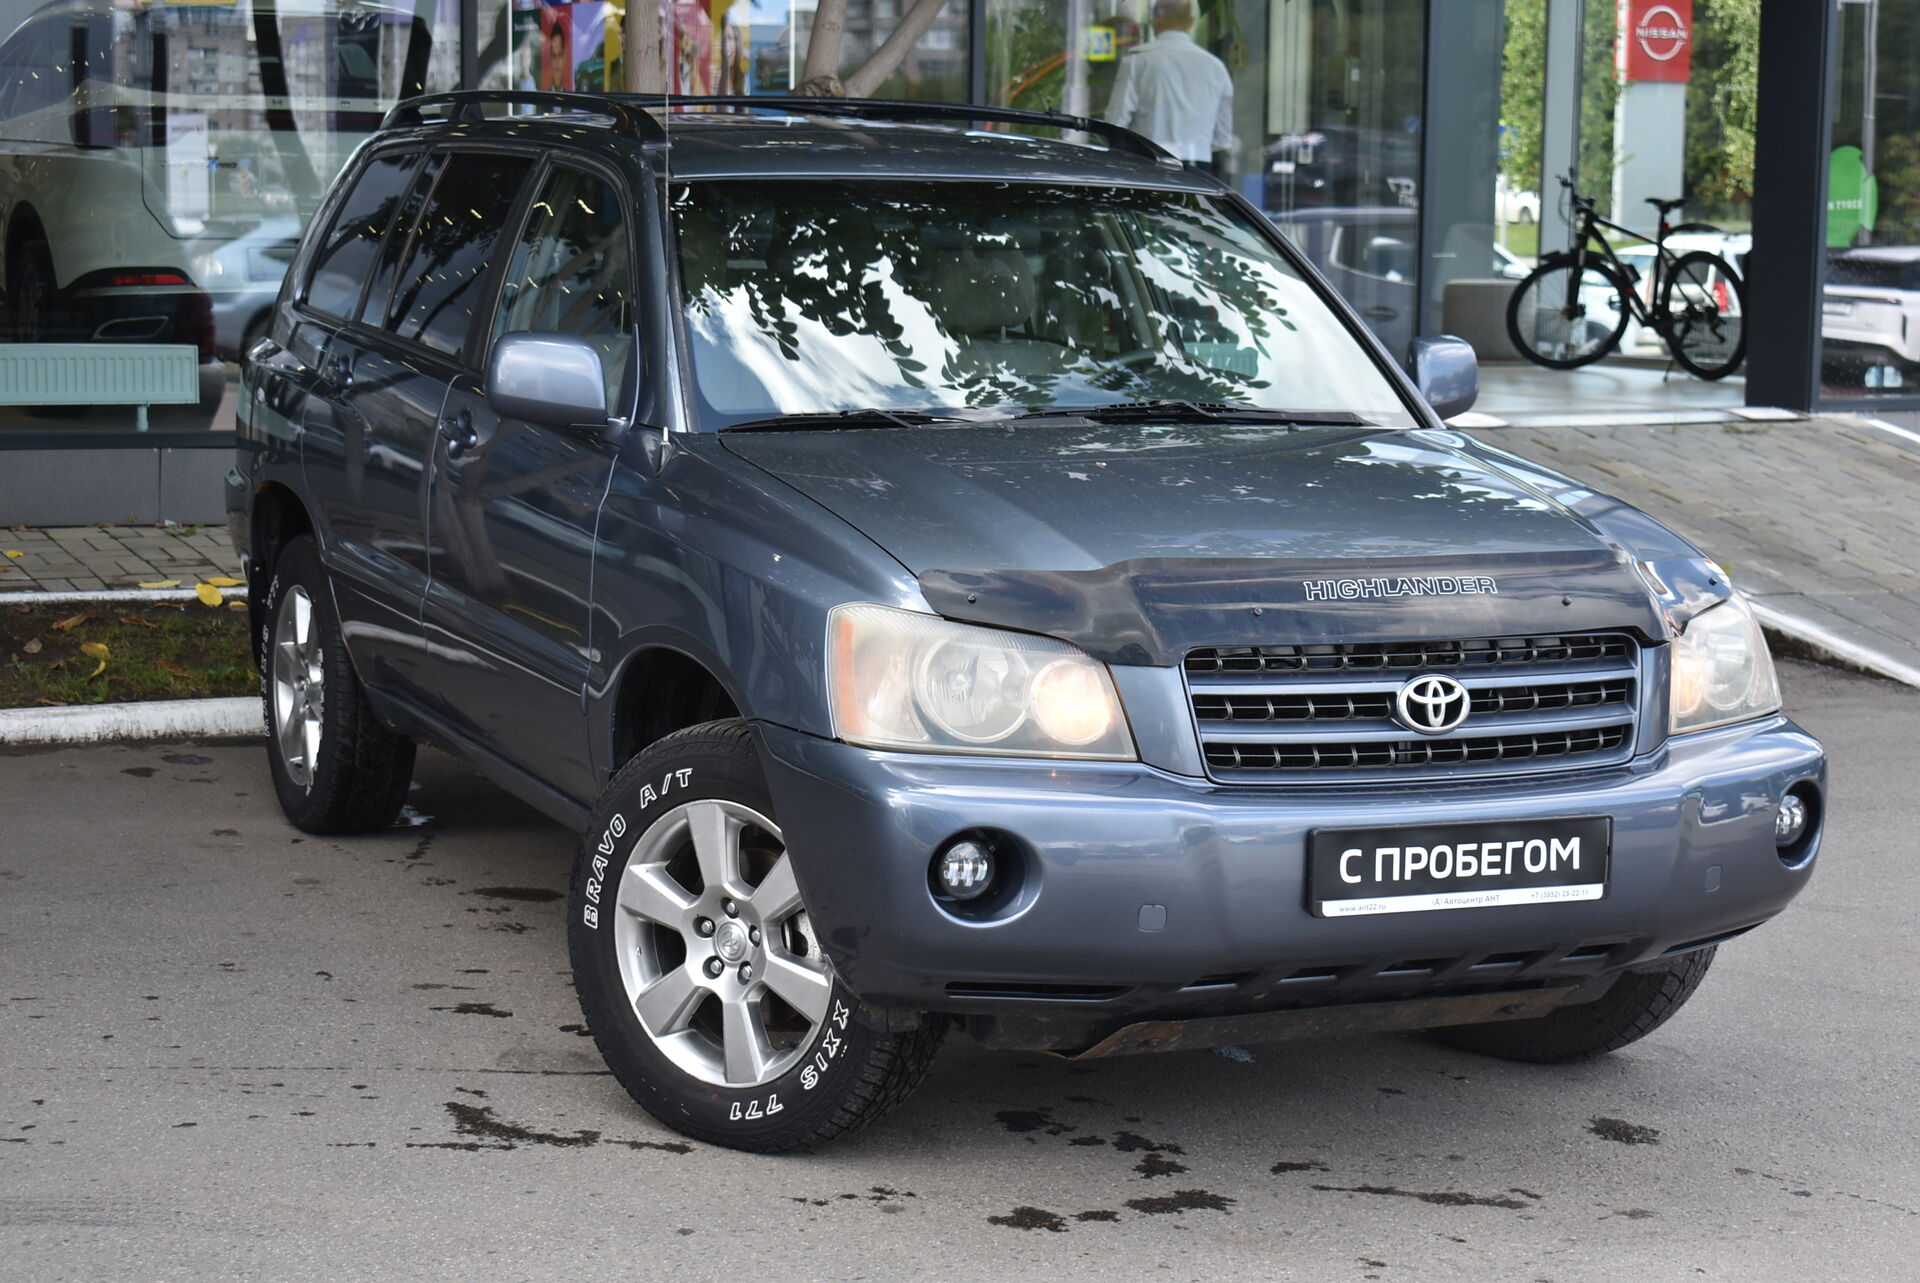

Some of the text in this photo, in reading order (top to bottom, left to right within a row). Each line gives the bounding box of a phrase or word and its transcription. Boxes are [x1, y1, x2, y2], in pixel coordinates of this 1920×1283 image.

[1635, 27, 1688, 39] NISSAN
[1303, 576, 1498, 600] HIGHLANDER
[583, 767, 693, 930] BRAVO A/T
[1339, 836, 1580, 884] С ПРОБЕГОМ
[1444, 897, 1483, 905] Автоцентр
[729, 999, 849, 1121] XXIS 771
